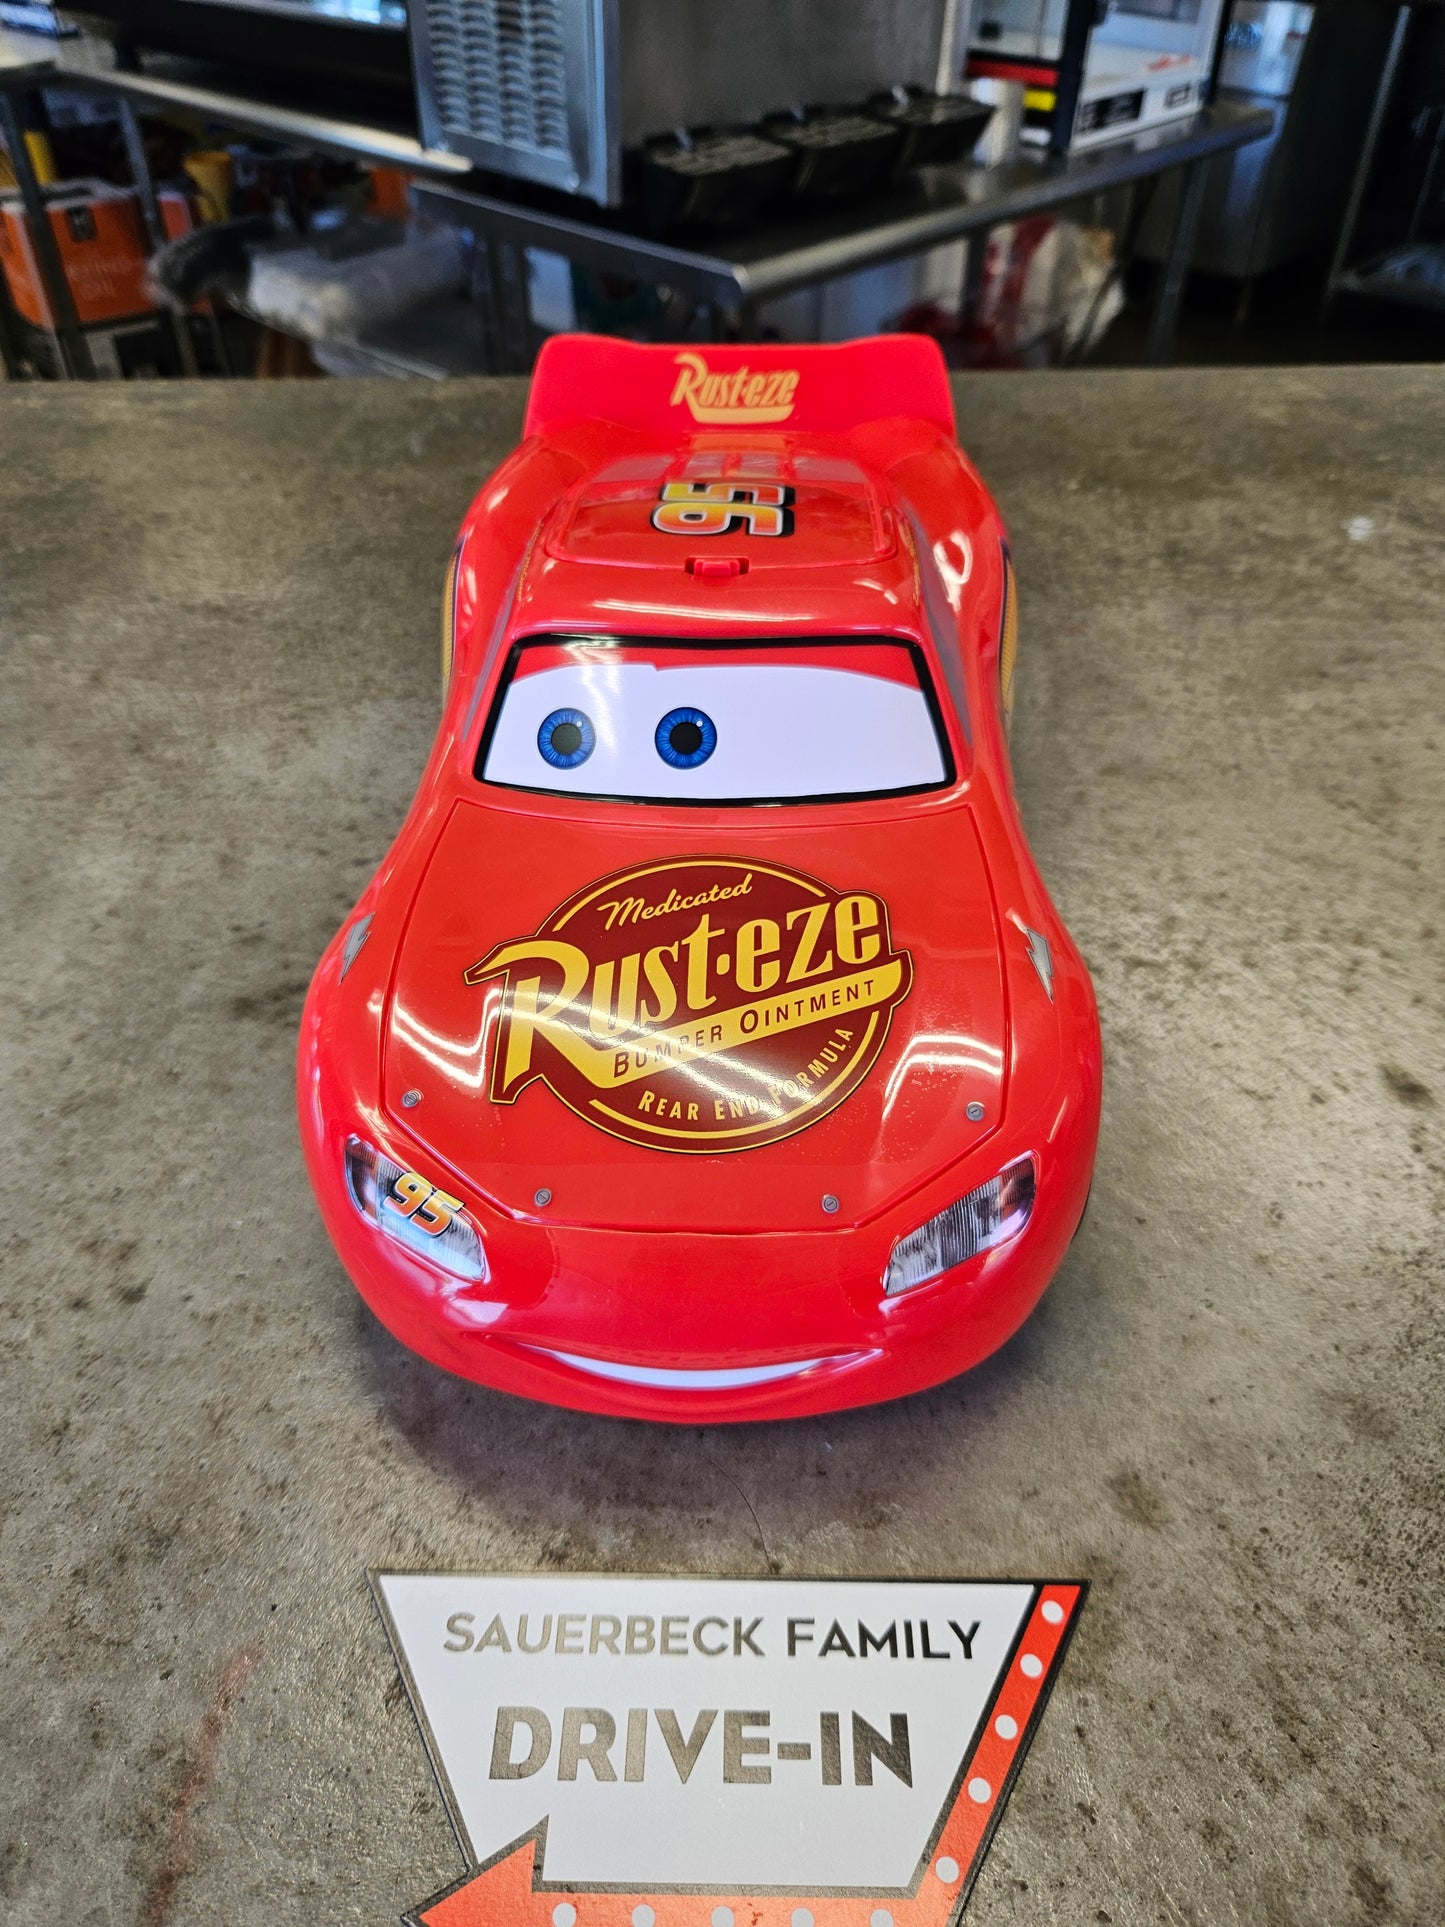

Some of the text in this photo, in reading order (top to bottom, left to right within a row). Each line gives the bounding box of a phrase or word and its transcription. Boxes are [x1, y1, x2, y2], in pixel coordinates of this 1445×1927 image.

[597, 872, 753, 931] Medicated
[613, 979, 875, 1078] BUMPER OINTMENT
[637, 1027, 854, 1121] REAR END FORMULA
[381, 1170, 466, 1238] 95
[442, 1611, 981, 1660] SAUERBECK FAMILY
[488, 1706, 914, 1789] DRIVE-IN
